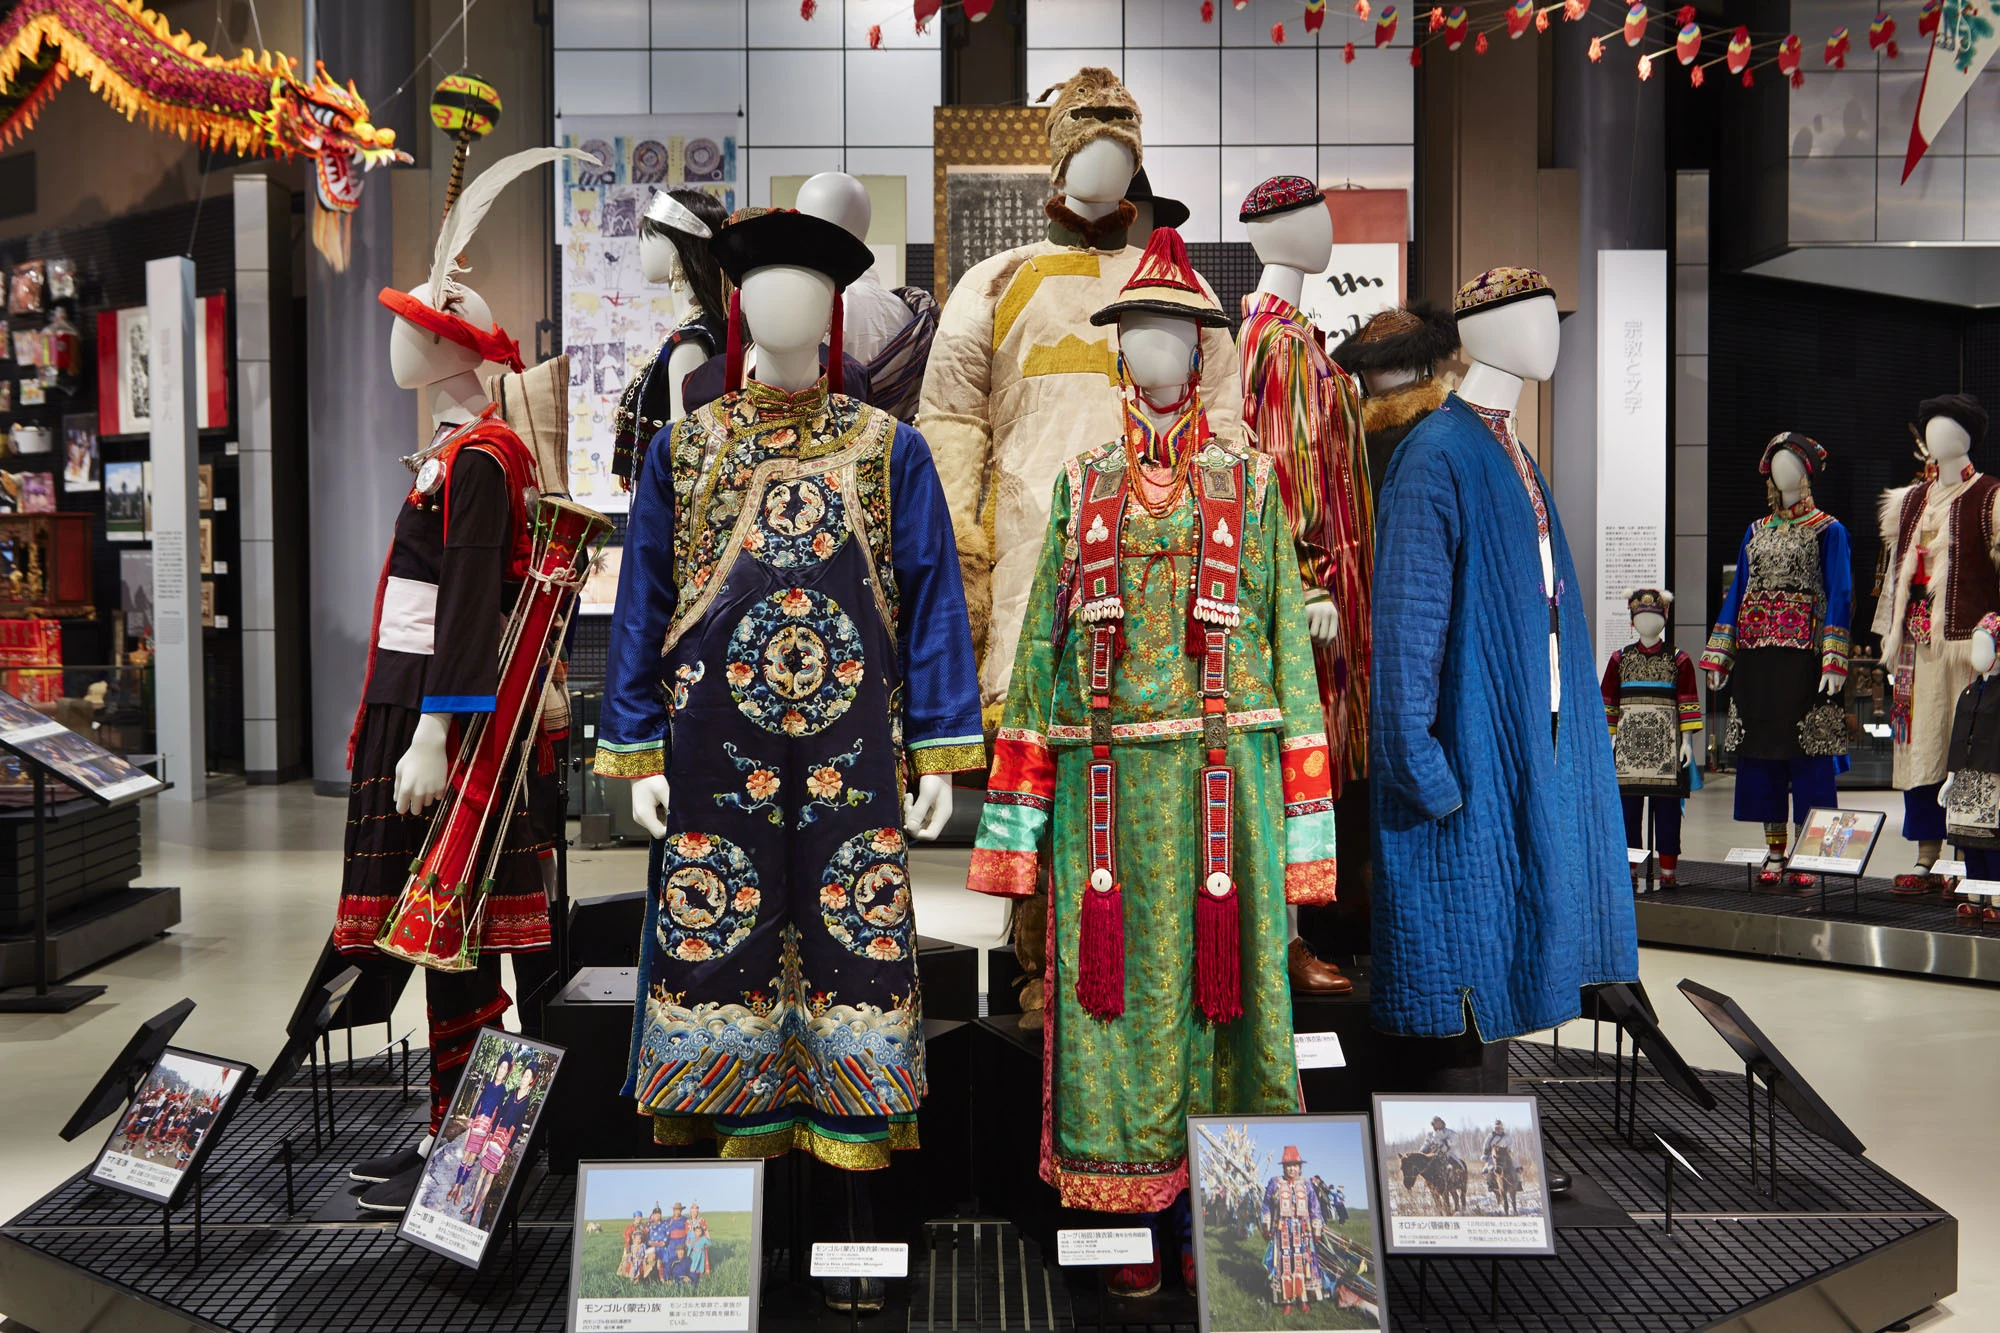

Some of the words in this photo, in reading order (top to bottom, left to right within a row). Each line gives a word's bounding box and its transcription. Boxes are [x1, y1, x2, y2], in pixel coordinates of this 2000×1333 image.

[584, 1303, 662, 1313] モンゴル(蒙古)族
